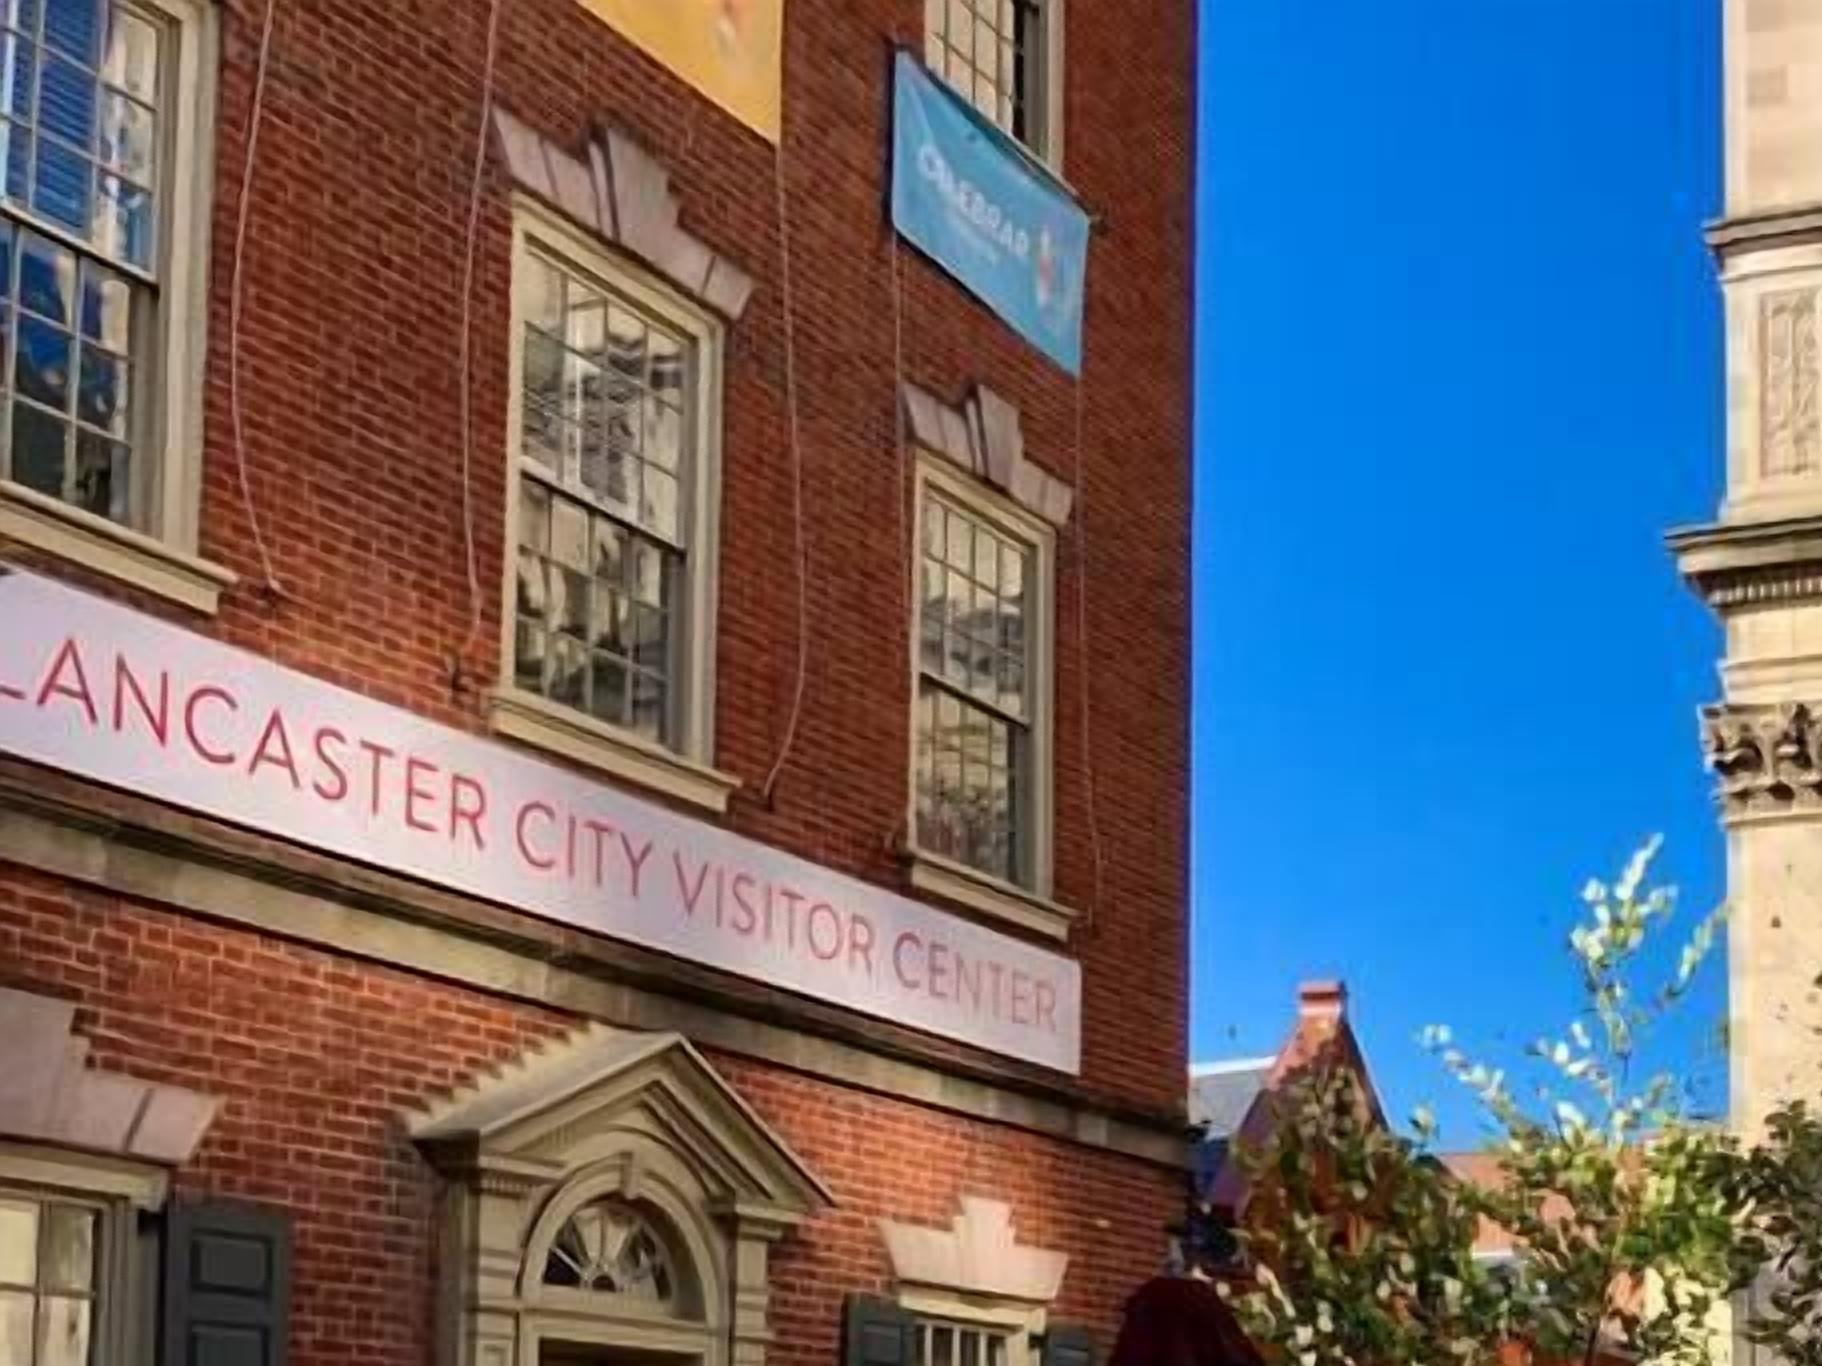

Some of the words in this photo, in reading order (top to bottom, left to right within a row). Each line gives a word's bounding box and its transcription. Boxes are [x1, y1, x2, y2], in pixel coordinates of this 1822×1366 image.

[514, 801, 653, 897] CITY
[672, 848, 876, 975] VISITOR
[893, 931, 1057, 1032] CENTER
